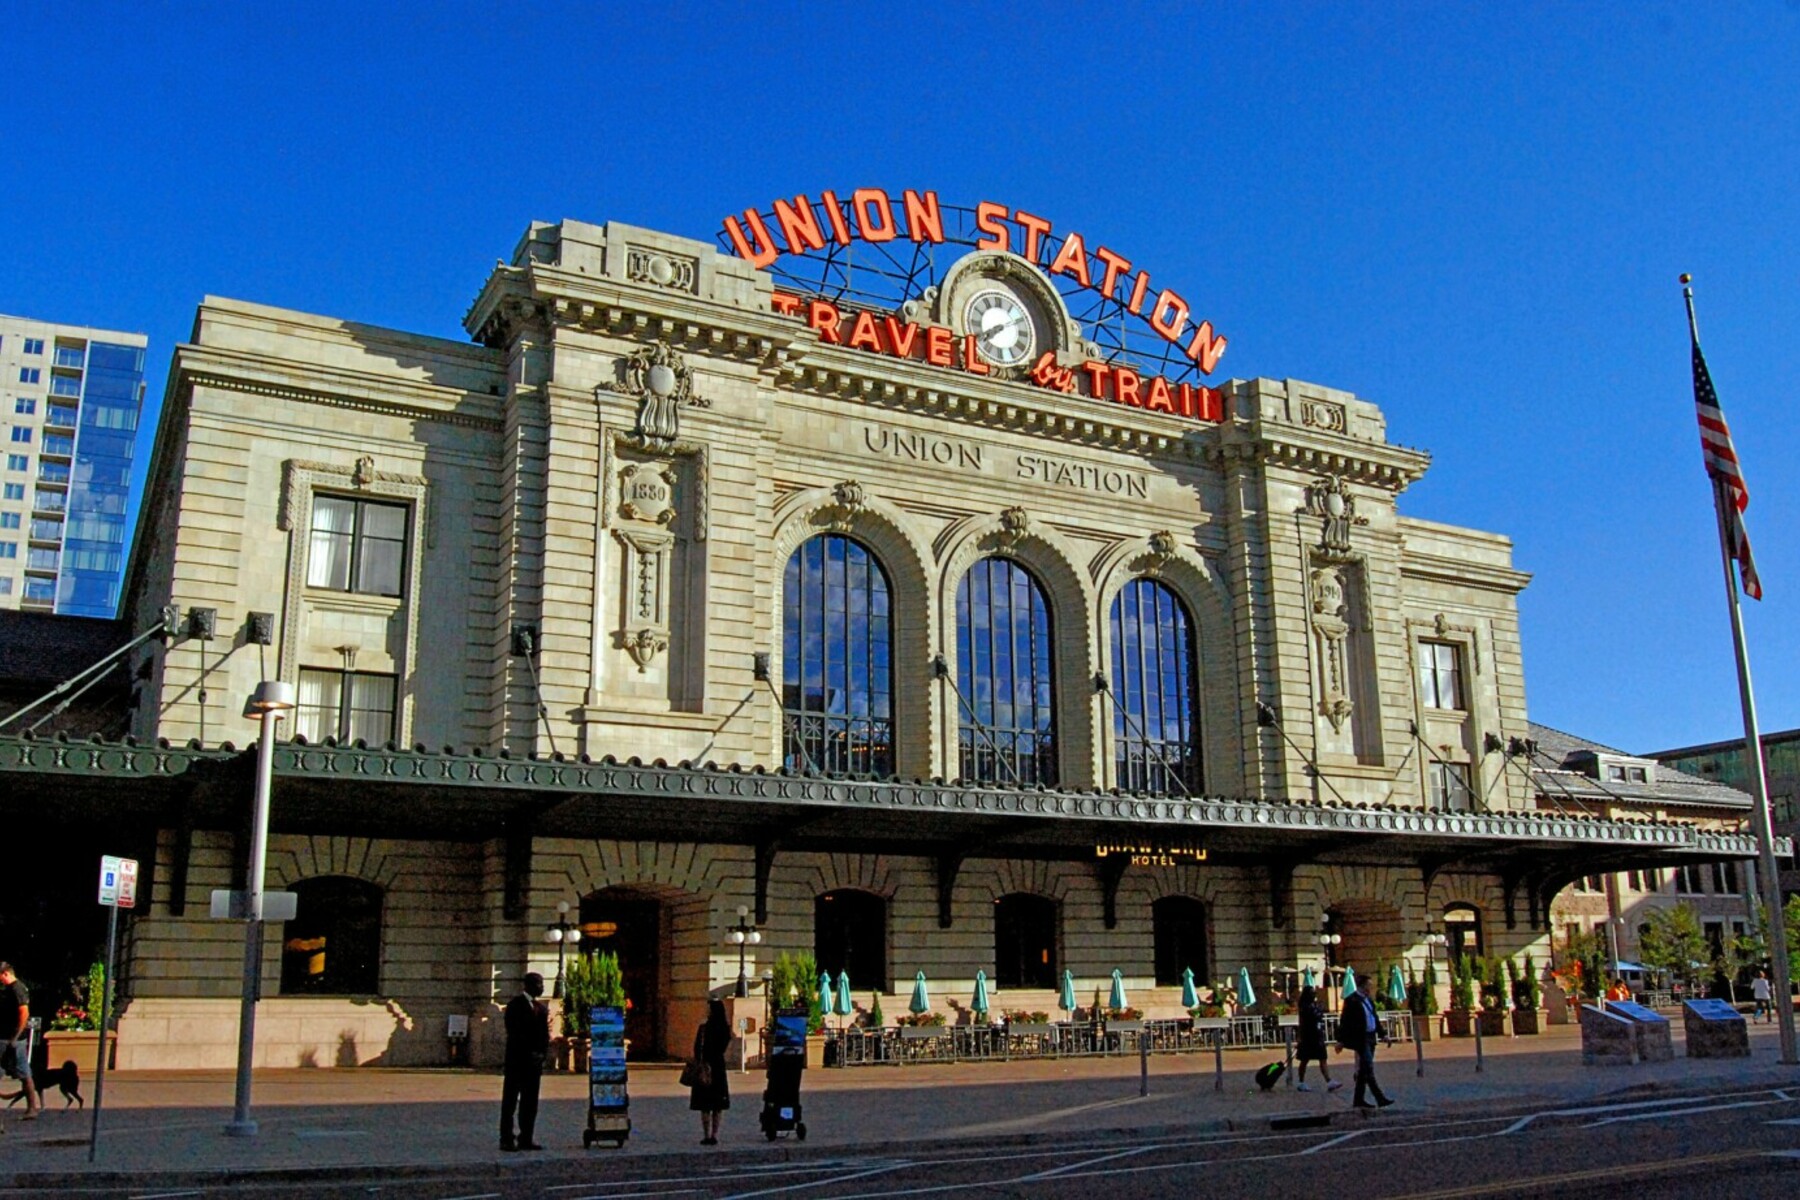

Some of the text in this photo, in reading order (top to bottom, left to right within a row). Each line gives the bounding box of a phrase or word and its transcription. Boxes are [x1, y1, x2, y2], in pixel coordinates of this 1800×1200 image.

[722, 187, 1228, 375] UNION STATION
[771, 290, 1224, 422] TRAVEL by TRAIN
[864, 427, 1147, 499] UNION STATION
[1131, 855, 1176, 866] HOTEL
